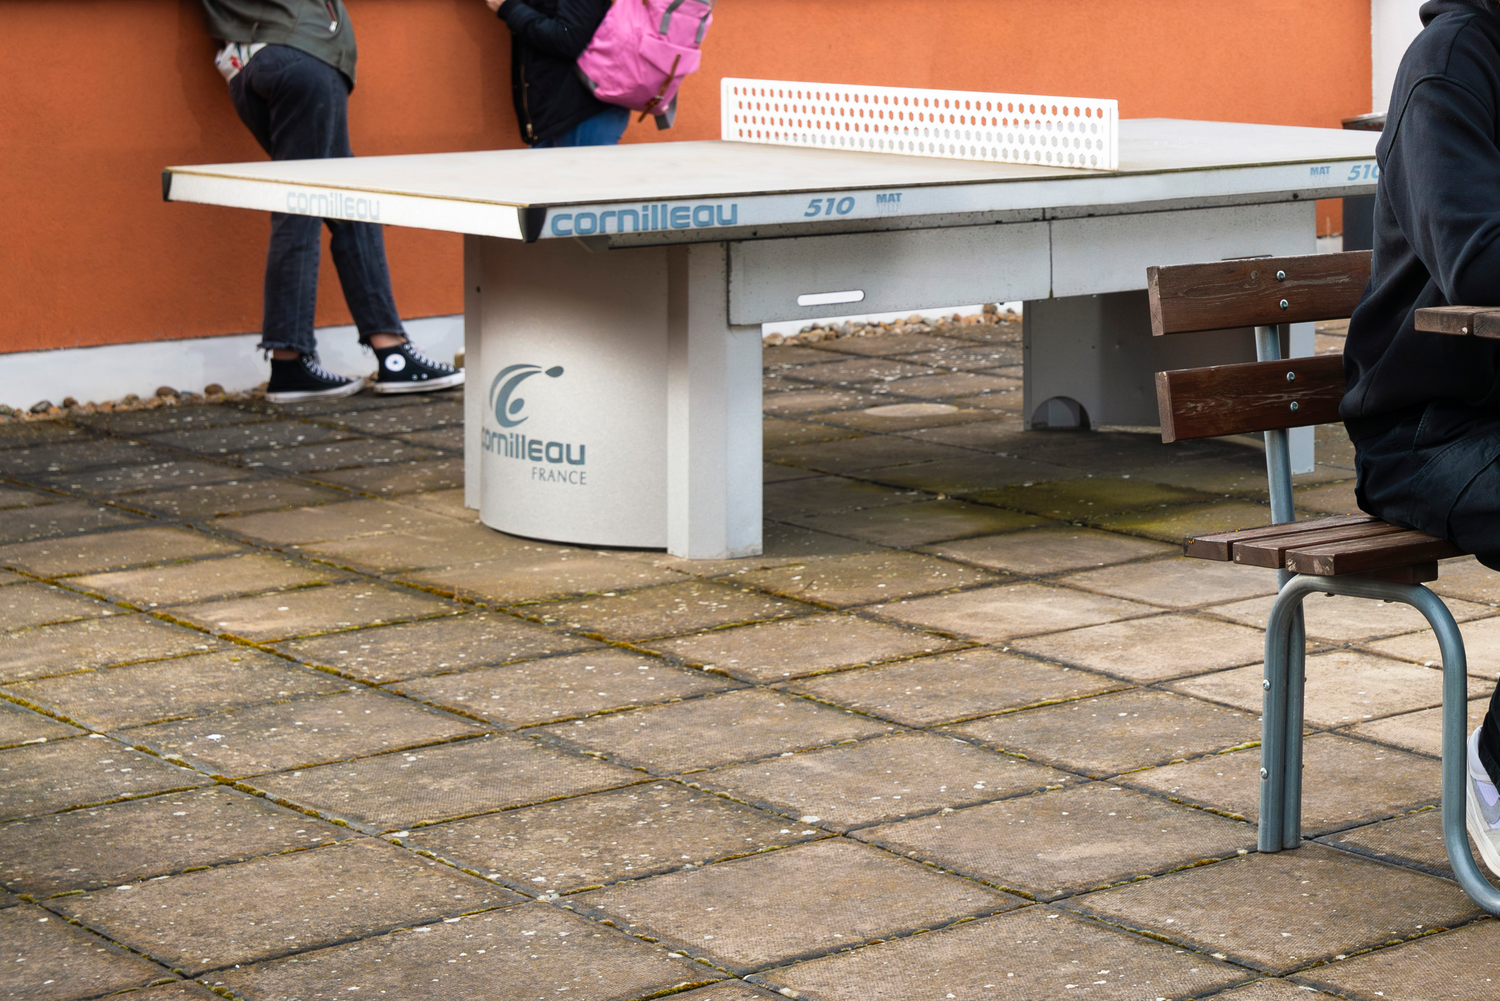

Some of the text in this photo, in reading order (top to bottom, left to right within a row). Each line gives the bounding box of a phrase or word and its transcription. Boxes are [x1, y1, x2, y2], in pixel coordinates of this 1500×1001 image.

[1310, 165, 1331, 176] MAT
[286, 191, 380, 221] cornilleau
[550, 192, 903, 237] cornilleau 510 MAT
[531, 466, 587, 486] FRANCE
